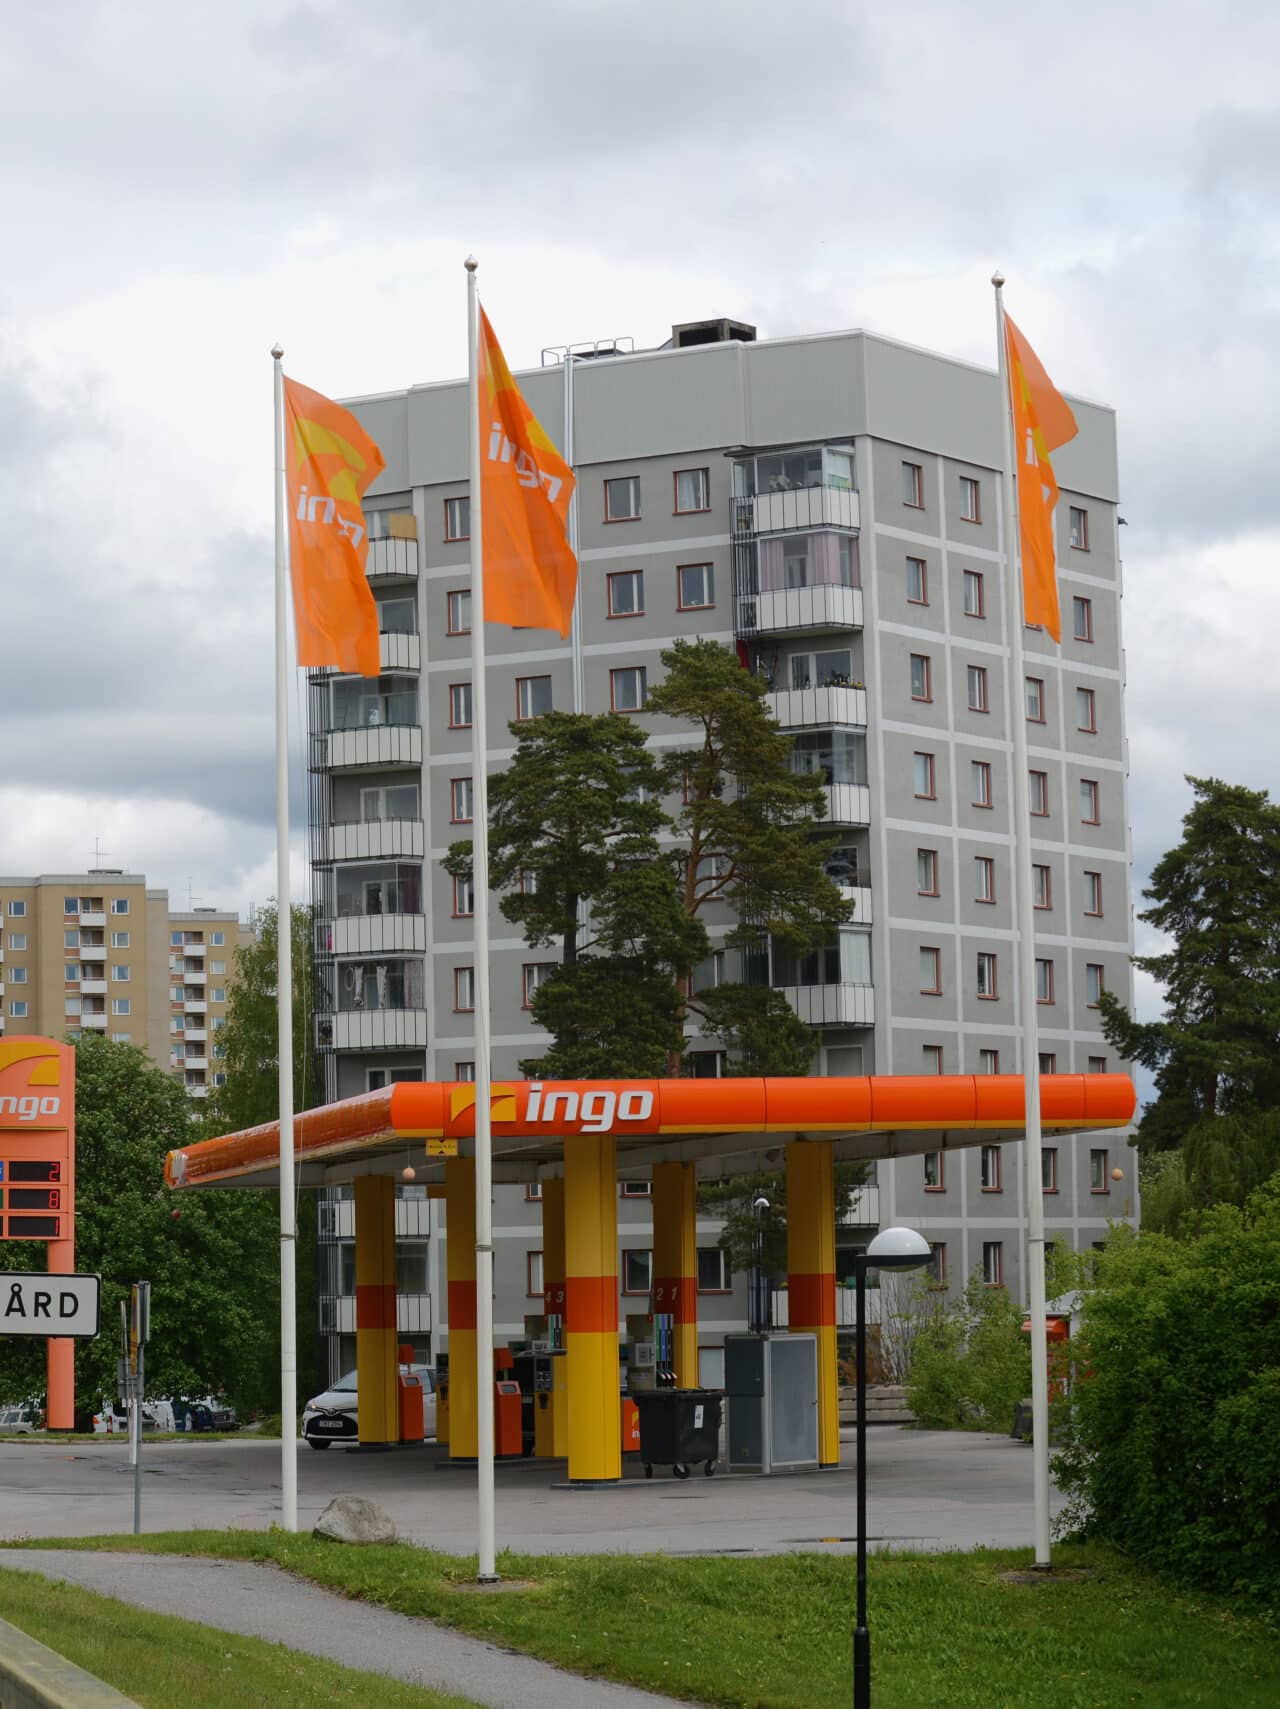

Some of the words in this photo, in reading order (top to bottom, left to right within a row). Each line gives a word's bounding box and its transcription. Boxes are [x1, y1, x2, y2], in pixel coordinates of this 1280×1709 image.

[525, 1082, 653, 1132] ingo
[49, 1163, 59, 1182] 2
[49, 1191, 59, 1208] 8
[557, 1291, 564, 1303] 3
